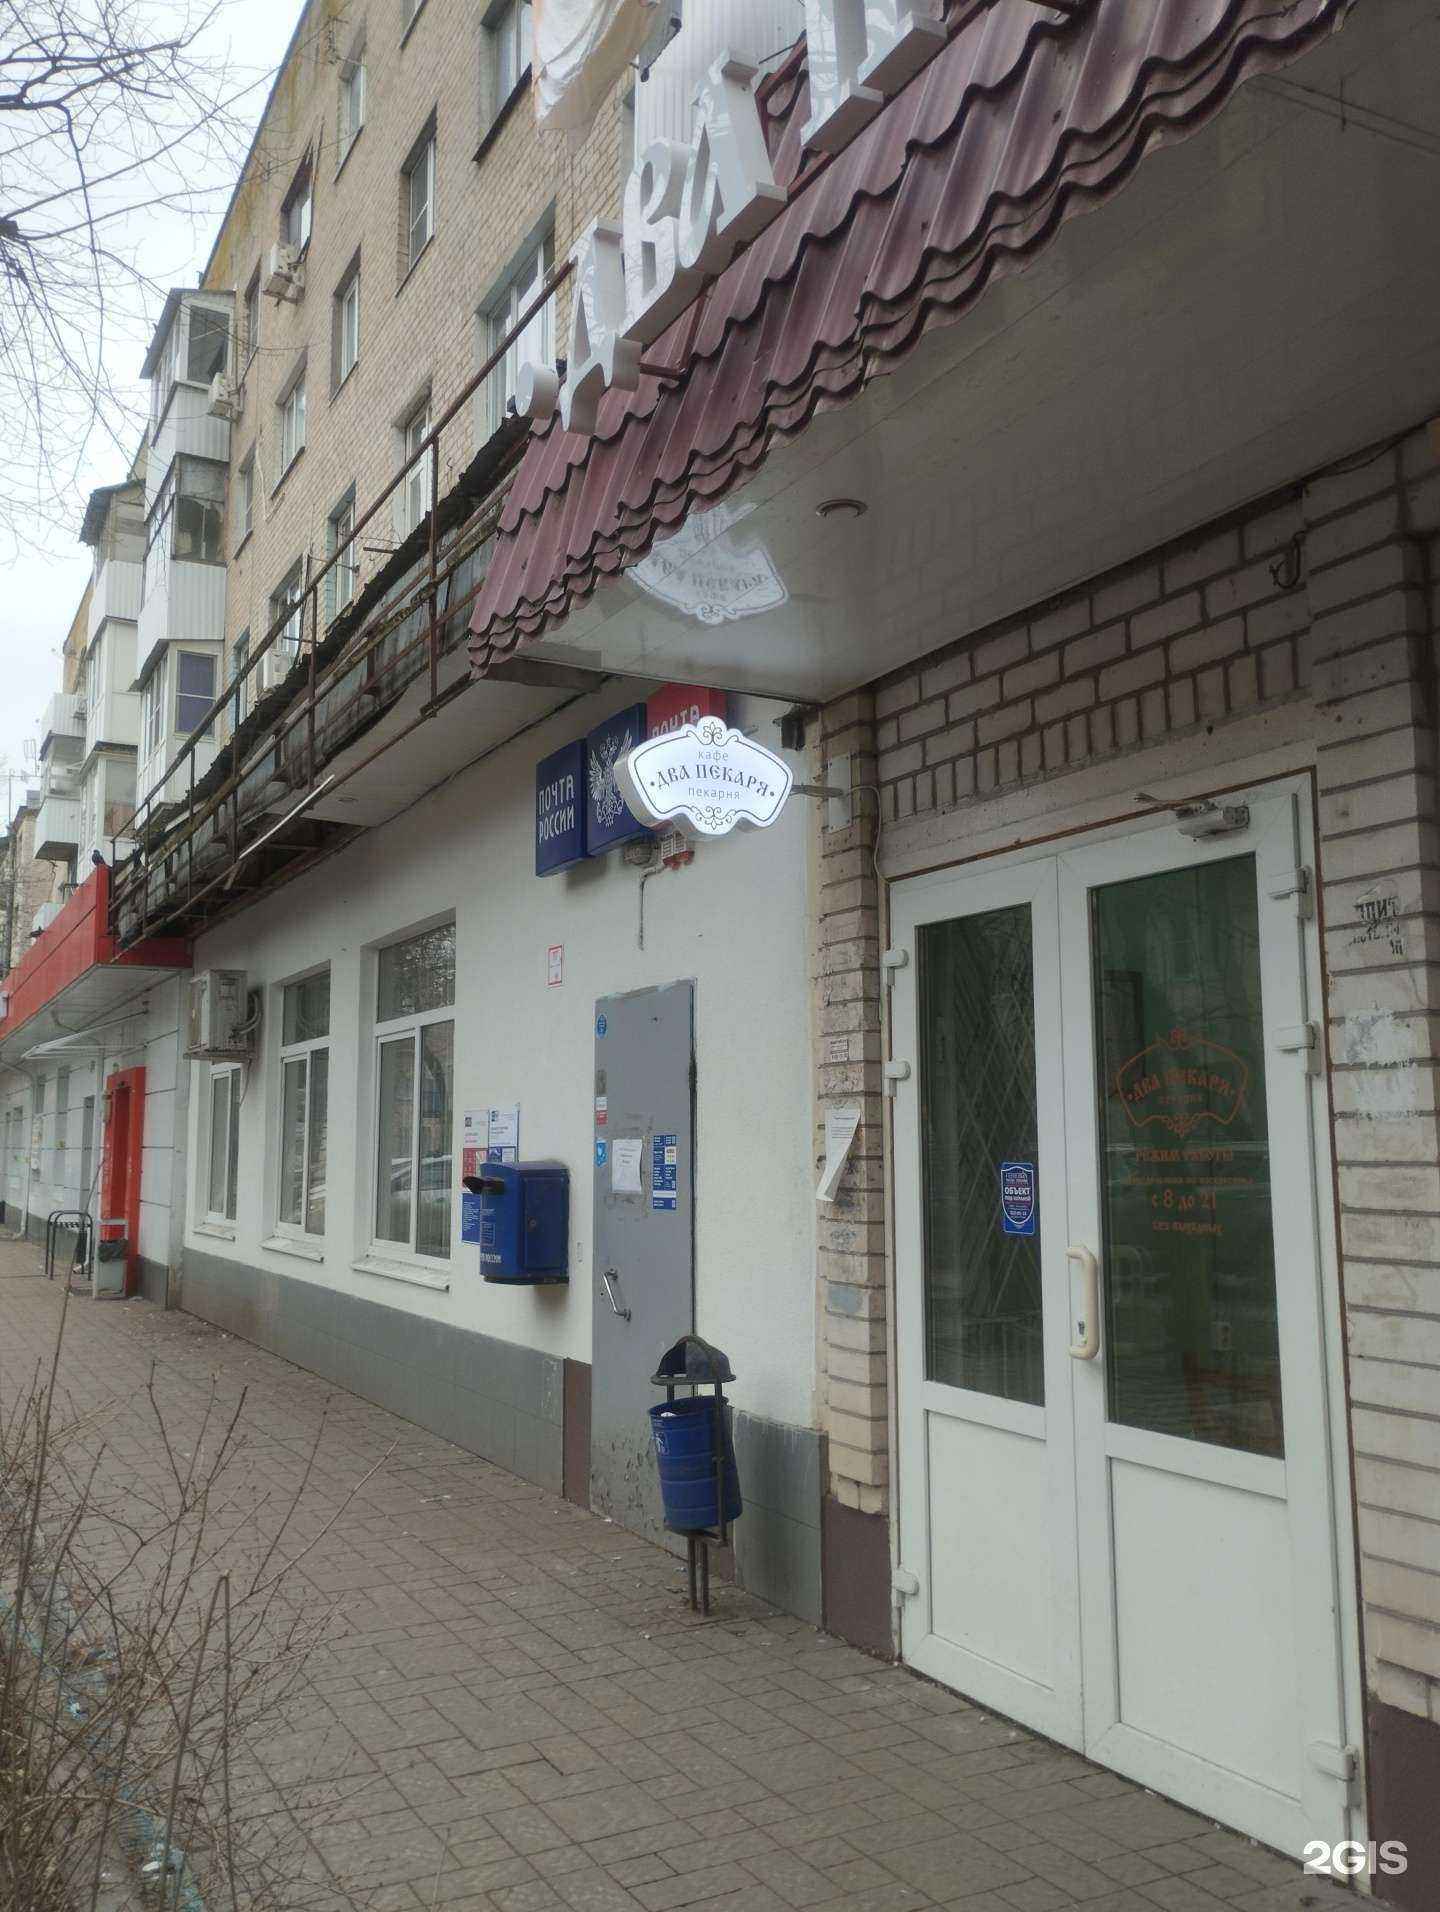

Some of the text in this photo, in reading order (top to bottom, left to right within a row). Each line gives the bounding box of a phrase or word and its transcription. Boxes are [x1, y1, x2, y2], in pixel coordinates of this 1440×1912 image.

[698, 751, 729, 762] кафе
[539, 774, 574, 815] ПОЧТА
[657, 764, 769, 797] ДВА ПЕКАРЯ
[688, 787, 740, 800] пекарня
[539, 804, 574, 844] РОССИИ
